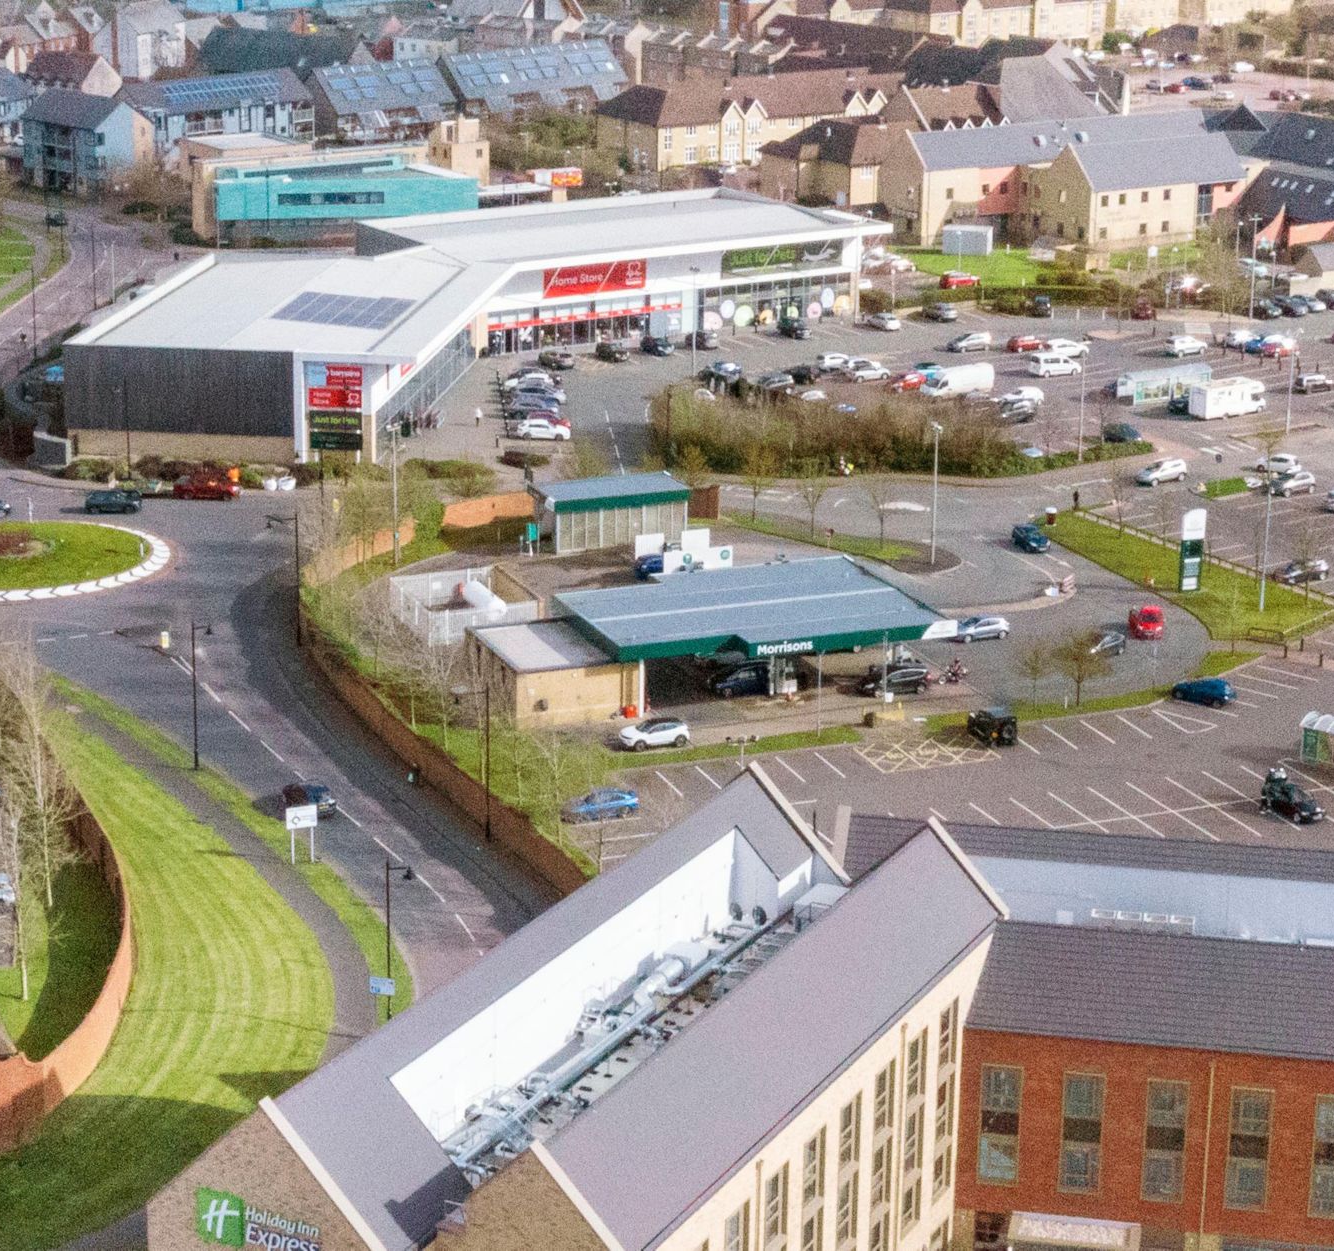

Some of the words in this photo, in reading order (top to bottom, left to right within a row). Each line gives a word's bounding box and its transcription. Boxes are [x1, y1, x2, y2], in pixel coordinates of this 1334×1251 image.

[551, 276, 578, 287] Home
[580, 273, 604, 284] Store
[756, 640, 814, 656] Morrisons
[245, 1206, 296, 1235] Holiday
[297, 1221, 320, 1239] Inn
[246, 1223, 320, 1251] Express
